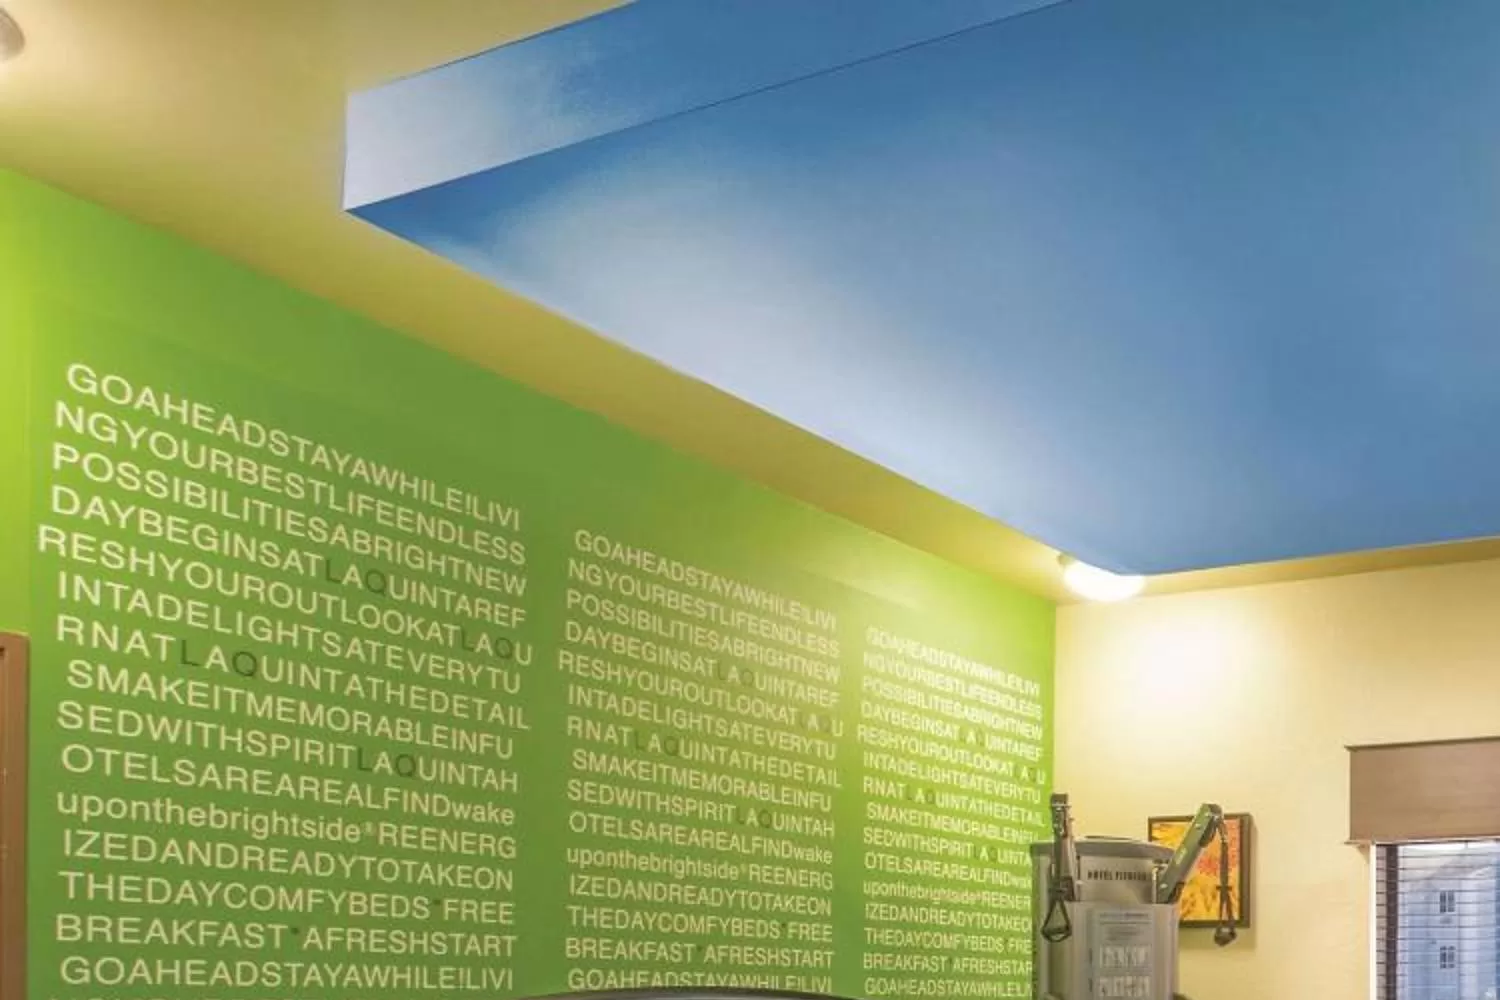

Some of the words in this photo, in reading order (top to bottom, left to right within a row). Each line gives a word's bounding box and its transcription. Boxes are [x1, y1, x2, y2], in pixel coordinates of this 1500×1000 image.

[55, 401, 526, 566] NGYOURBESTLIFEENDLESS
[52, 443, 527, 597] POSSIBILITIESABRIGHTNEW
[58, 571, 521, 695] INTADELIGHTSATEVERYTU
[566, 588, 840, 684] POSSIBILITIESABRIGHTNEW
[568, 558, 840, 658] NGYOURBESTLIFEENDLESS
[57, 615, 531, 730] RNATLAQUINTATHEDETAIL
[67, 659, 513, 760] SMAKEITMEMORABLEINFU
[568, 684, 836, 760] INTADELIGHTSATEVERYTU
[57, 701, 518, 793] SEDWITHSPIRITLAQUINTAH
[573, 748, 832, 812] SMAKEITMEMORABLEINFU
[64, 829, 513, 891] IZEDANDREADYTOTAKEON
[570, 873, 831, 915] IZEDANDREADYTOTAKEON
[58, 871, 429, 919] THEDAYCOMFYBEDS
[443, 899, 514, 924] FREE
[566, 905, 780, 939] THEDAYCOMFYBEDS
[787, 921, 833, 942] FREE
[865, 903, 1031, 933] IZEDANDREADYTOTAKEO
[56, 914, 288, 948] BREAKFAST
[304, 928, 518, 957] AFRESHSTART
[565, 937, 696, 962] BREAKFAST
[703, 944, 834, 968] AFRESHSTART
[863, 952, 947, 973] BREAKFAST
[953, 956, 1032, 977] AFRESHSTAR
